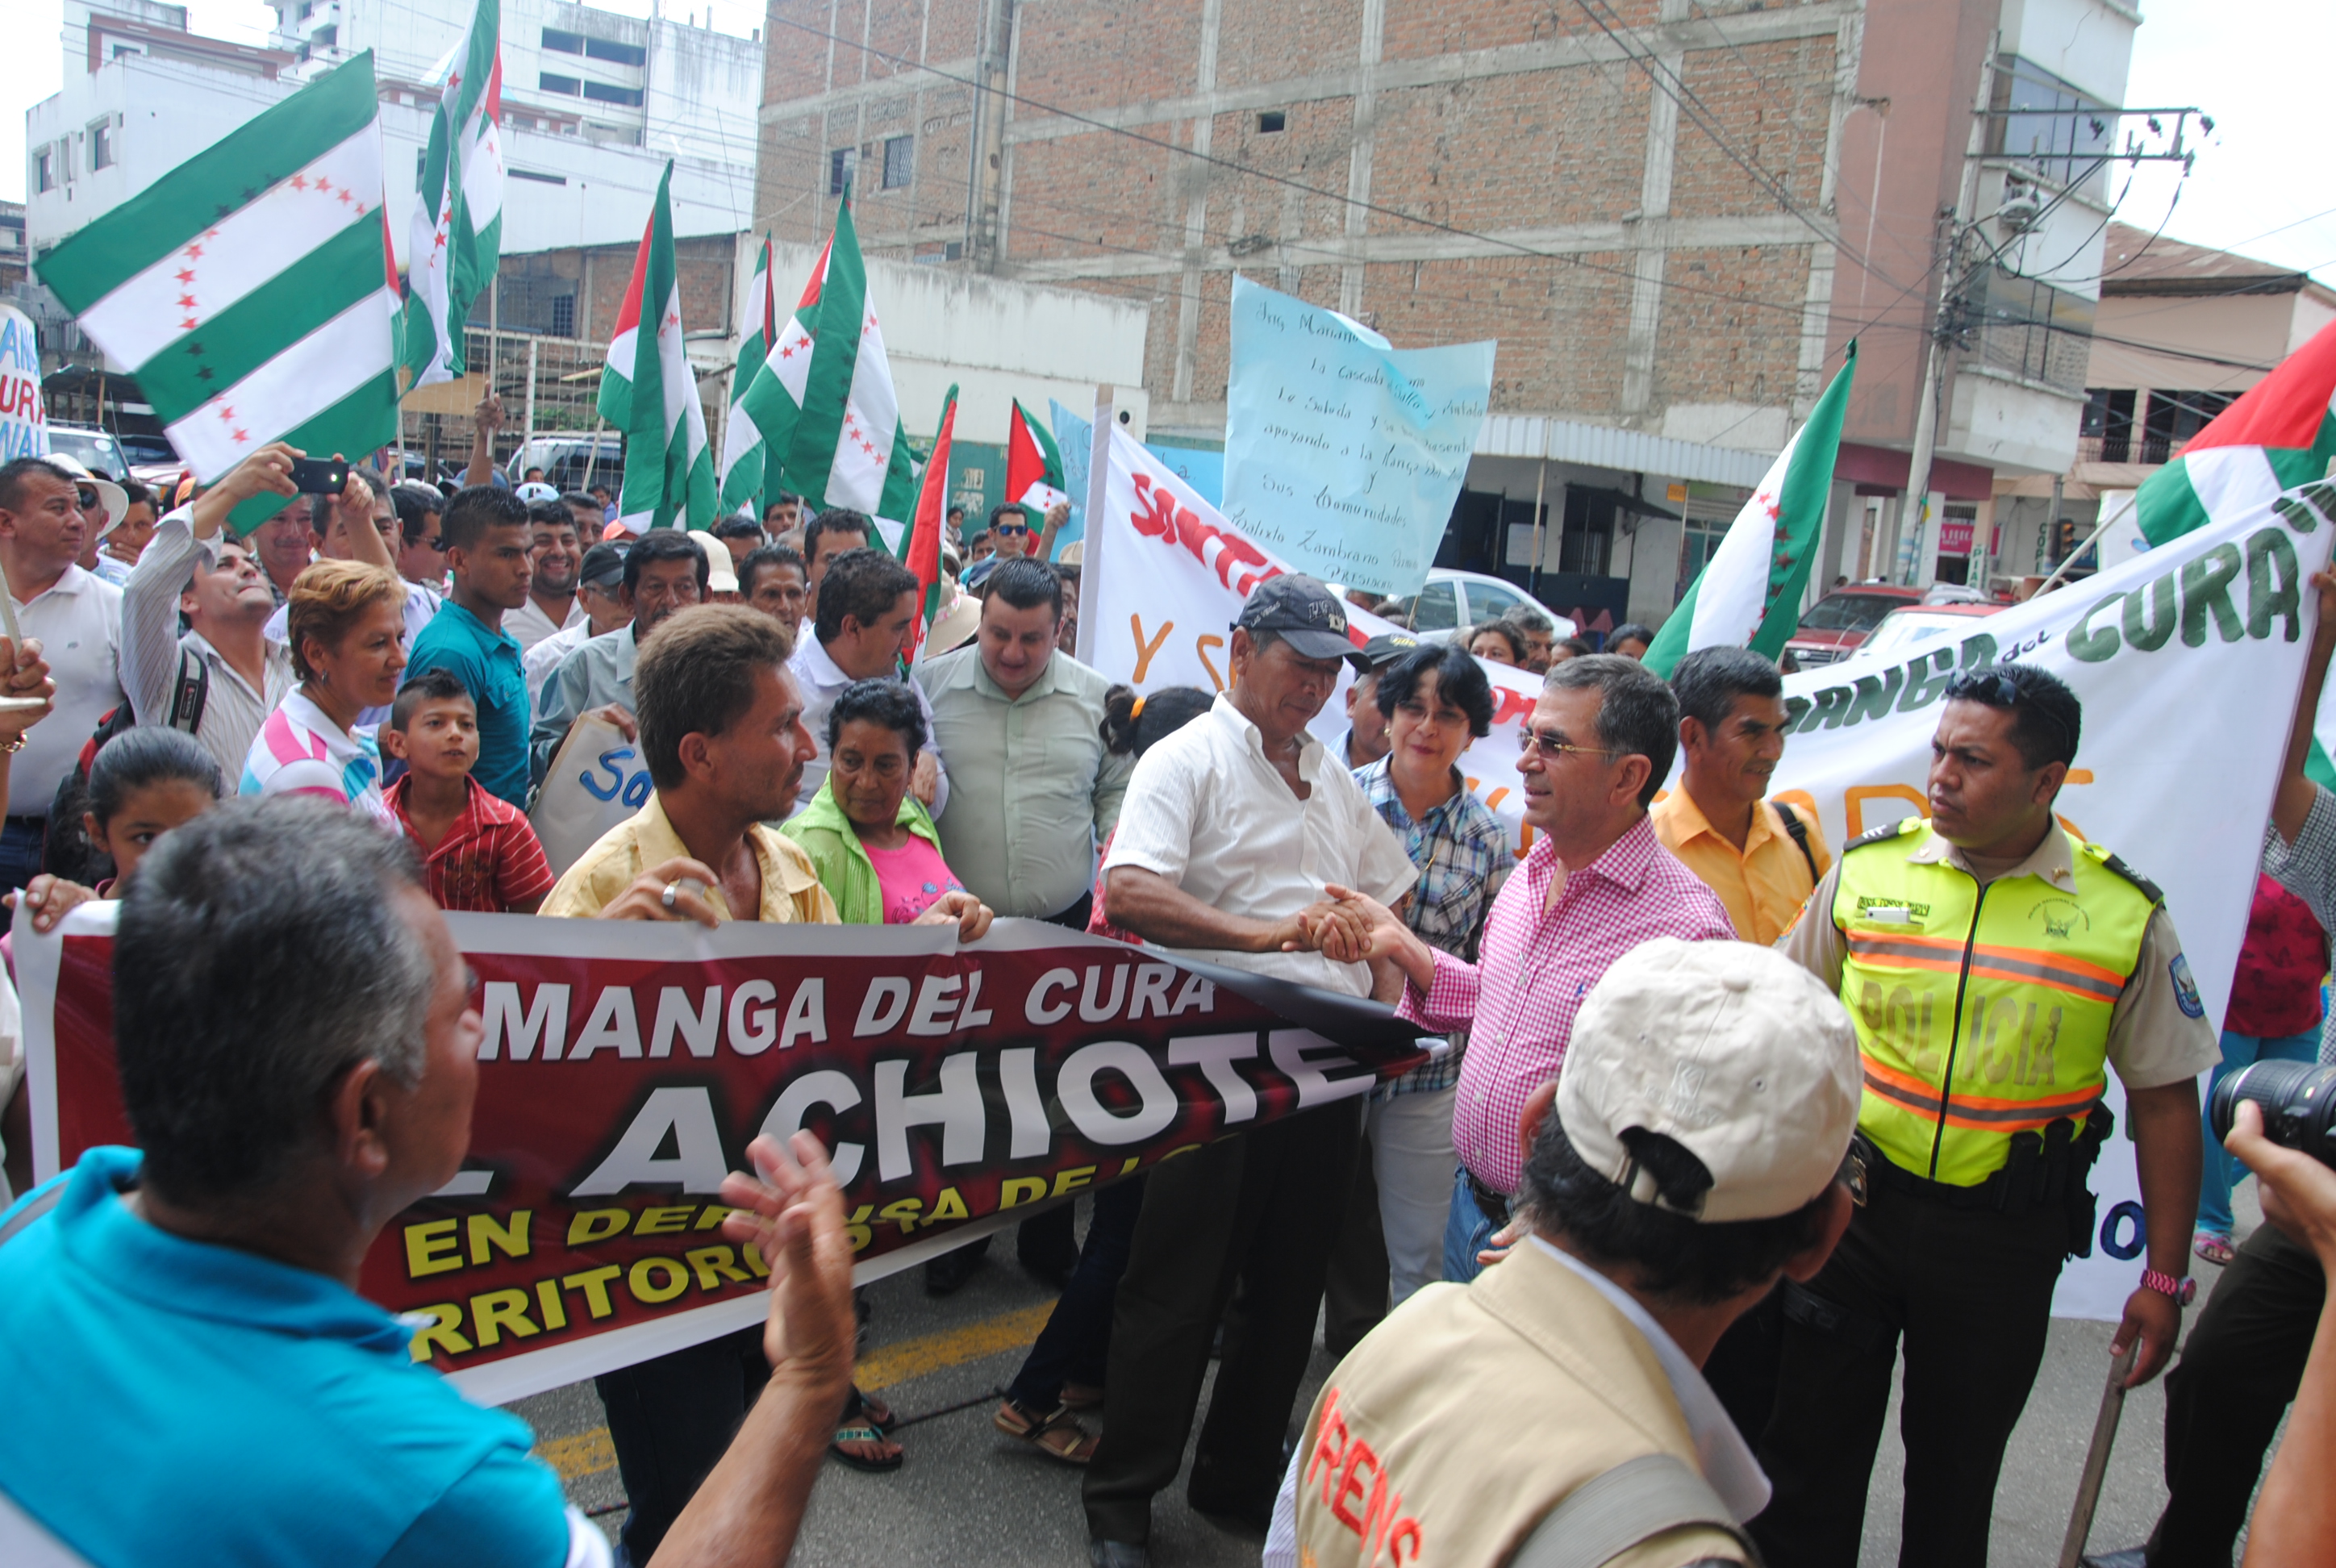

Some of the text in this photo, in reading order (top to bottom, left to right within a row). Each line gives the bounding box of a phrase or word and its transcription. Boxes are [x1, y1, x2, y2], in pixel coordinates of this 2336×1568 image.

[1311, 357, 1326, 375] La
[1338, 365, 1385, 386] Cascada
[1263, 423, 1330, 452] apoyando
[1341, 444, 1349, 457] a
[1359, 443, 1373, 461] la
[1304, 396, 1351, 420] Saluda
[1370, 415, 1379, 430] y
[1295, 528, 1379, 566] Zambrano
[2065, 528, 2300, 663] CURA
[1130, 612, 1174, 684] Y
[2001, 629, 2051, 663] del
[477, 964, 1217, 1061] MANGA DEL CURA
[1859, 979, 2063, 1086] POLICIA
[568, 1028, 1377, 1197] ACHIOTE
[405, 1210, 533, 1278] EN
[997, 1165, 1097, 1211] DE
